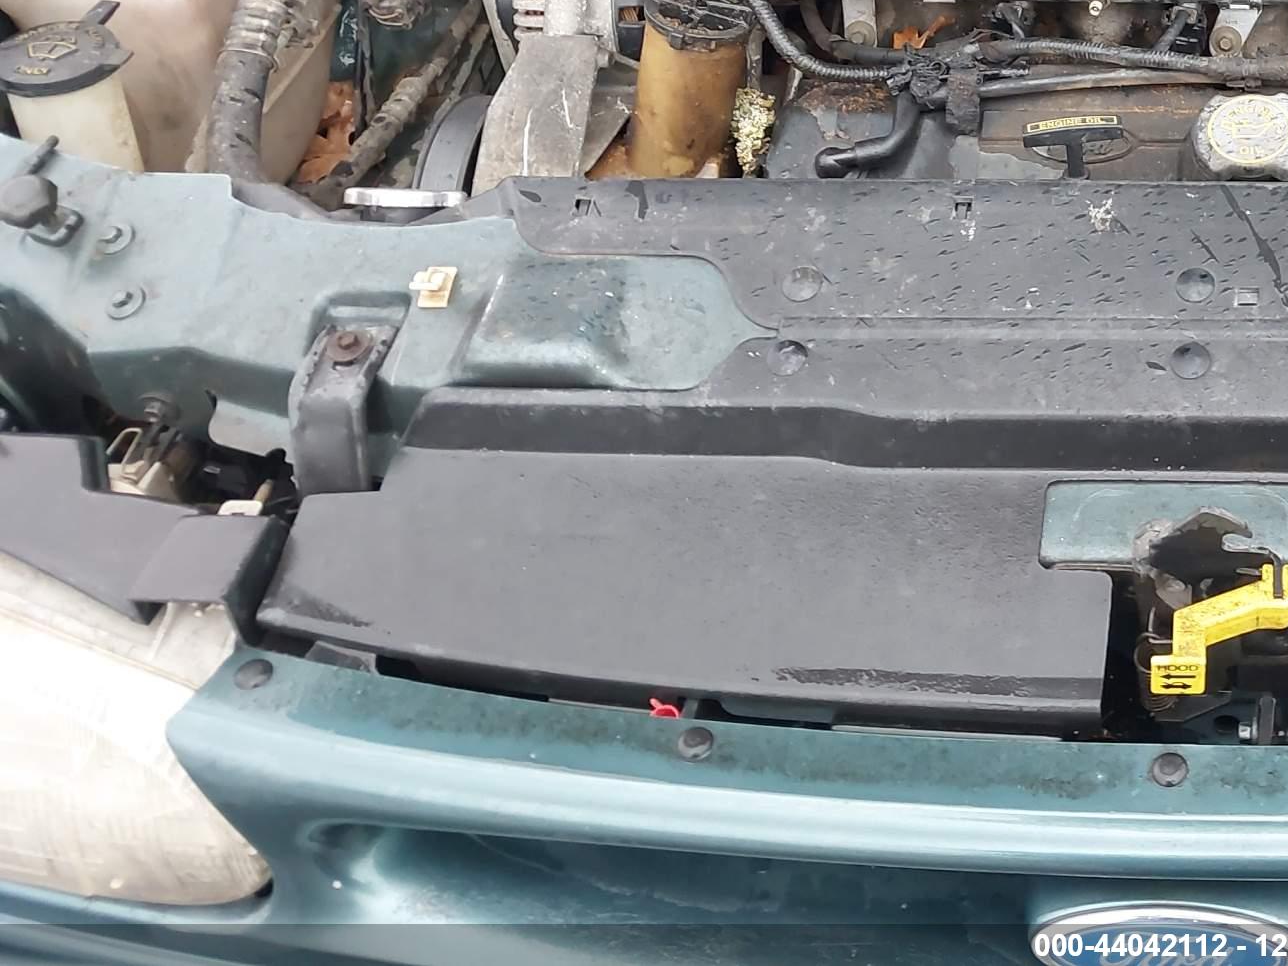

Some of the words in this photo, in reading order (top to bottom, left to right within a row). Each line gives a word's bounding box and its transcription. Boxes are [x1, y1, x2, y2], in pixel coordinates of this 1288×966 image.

[1040, 117, 1082, 132] ENGINE
[1239, 145, 1264, 156] OIL
[1157, 664, 1199, 672] HOOD
